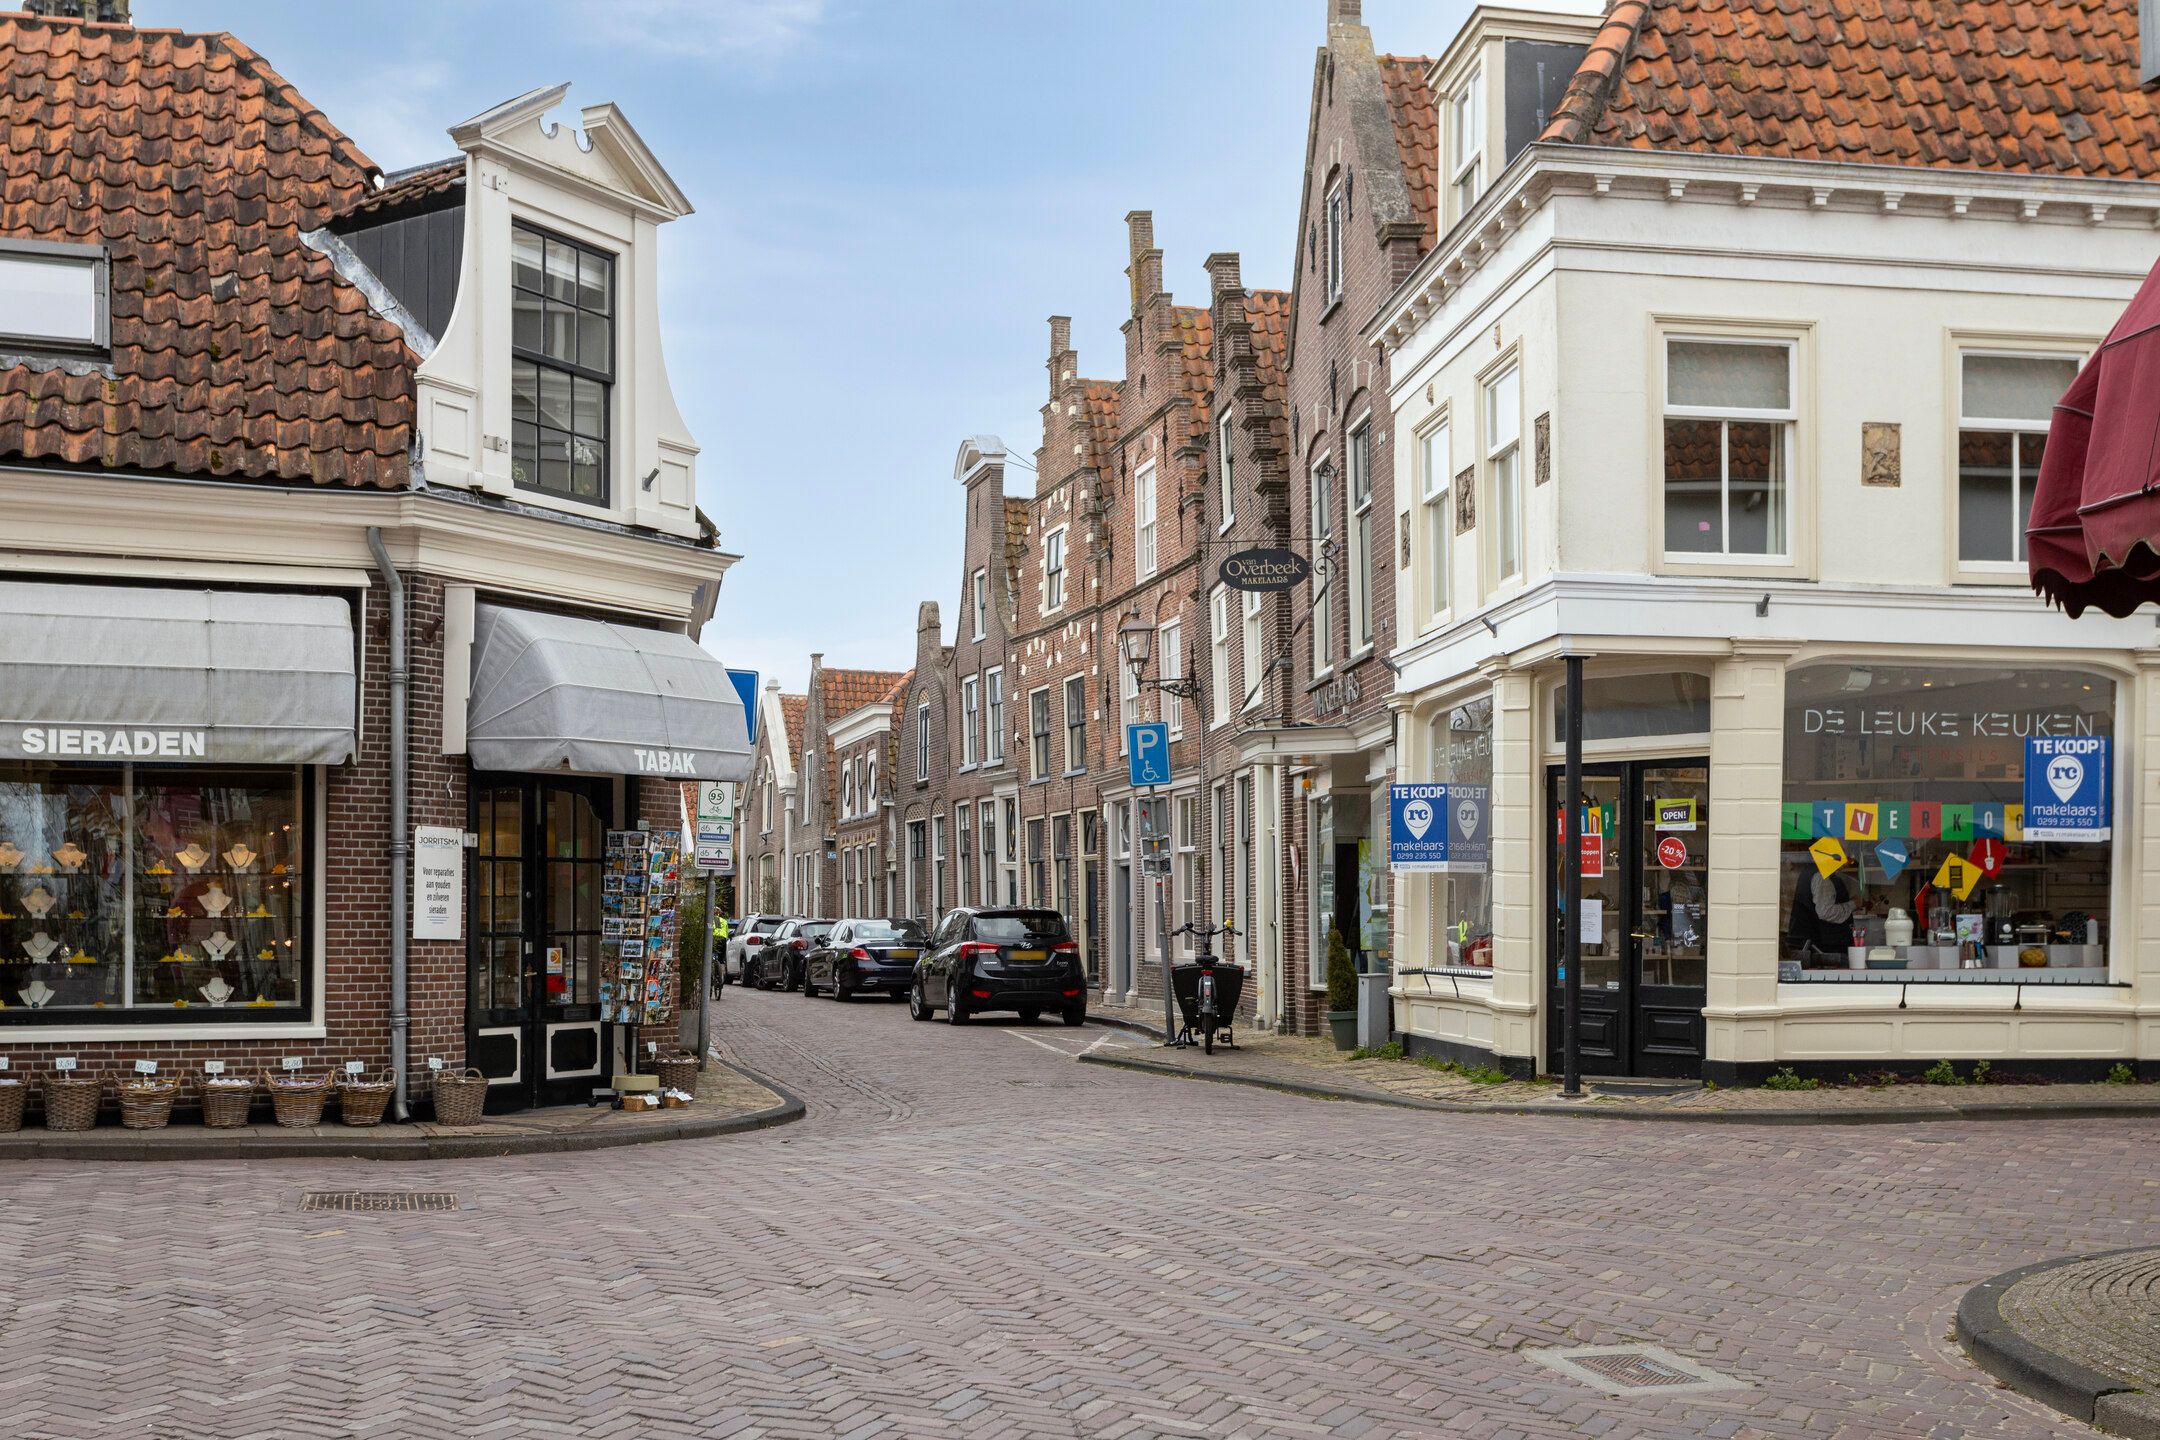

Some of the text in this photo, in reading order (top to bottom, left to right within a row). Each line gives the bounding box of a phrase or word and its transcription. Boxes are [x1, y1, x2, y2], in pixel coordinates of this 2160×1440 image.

[1226, 558, 1302, 576] Overbeek
[1242, 576, 1288, 584] MAKELAARS
[1804, 709, 2093, 737] DE LEUKE KEUKEN
[22, 727, 205, 756] SIERADEN
[1136, 729, 1159, 760] P
[2032, 740, 2099, 754] TE KOOP
[634, 749, 696, 774] TABAK
[2052, 766, 2078, 780] rc
[710, 792, 722, 800] 95
[1392, 786, 1446, 799] TE KOOP
[1408, 809, 1428, 821] rc
[1662, 810, 1686, 820] OPEN!
[2032, 804, 2097, 816] makelaars
[2060, 818, 2075, 826] 235
[2078, 818, 2093, 826] 550
[418, 836, 460, 846] JORRITSMA
[1393, 840, 1444, 850] makelaars
[422, 867, 454, 878] Voor reparaties
[435, 880, 450, 891] gouden
[433, 892, 450, 902] zilveren
[428, 905, 447, 914] sieraden
